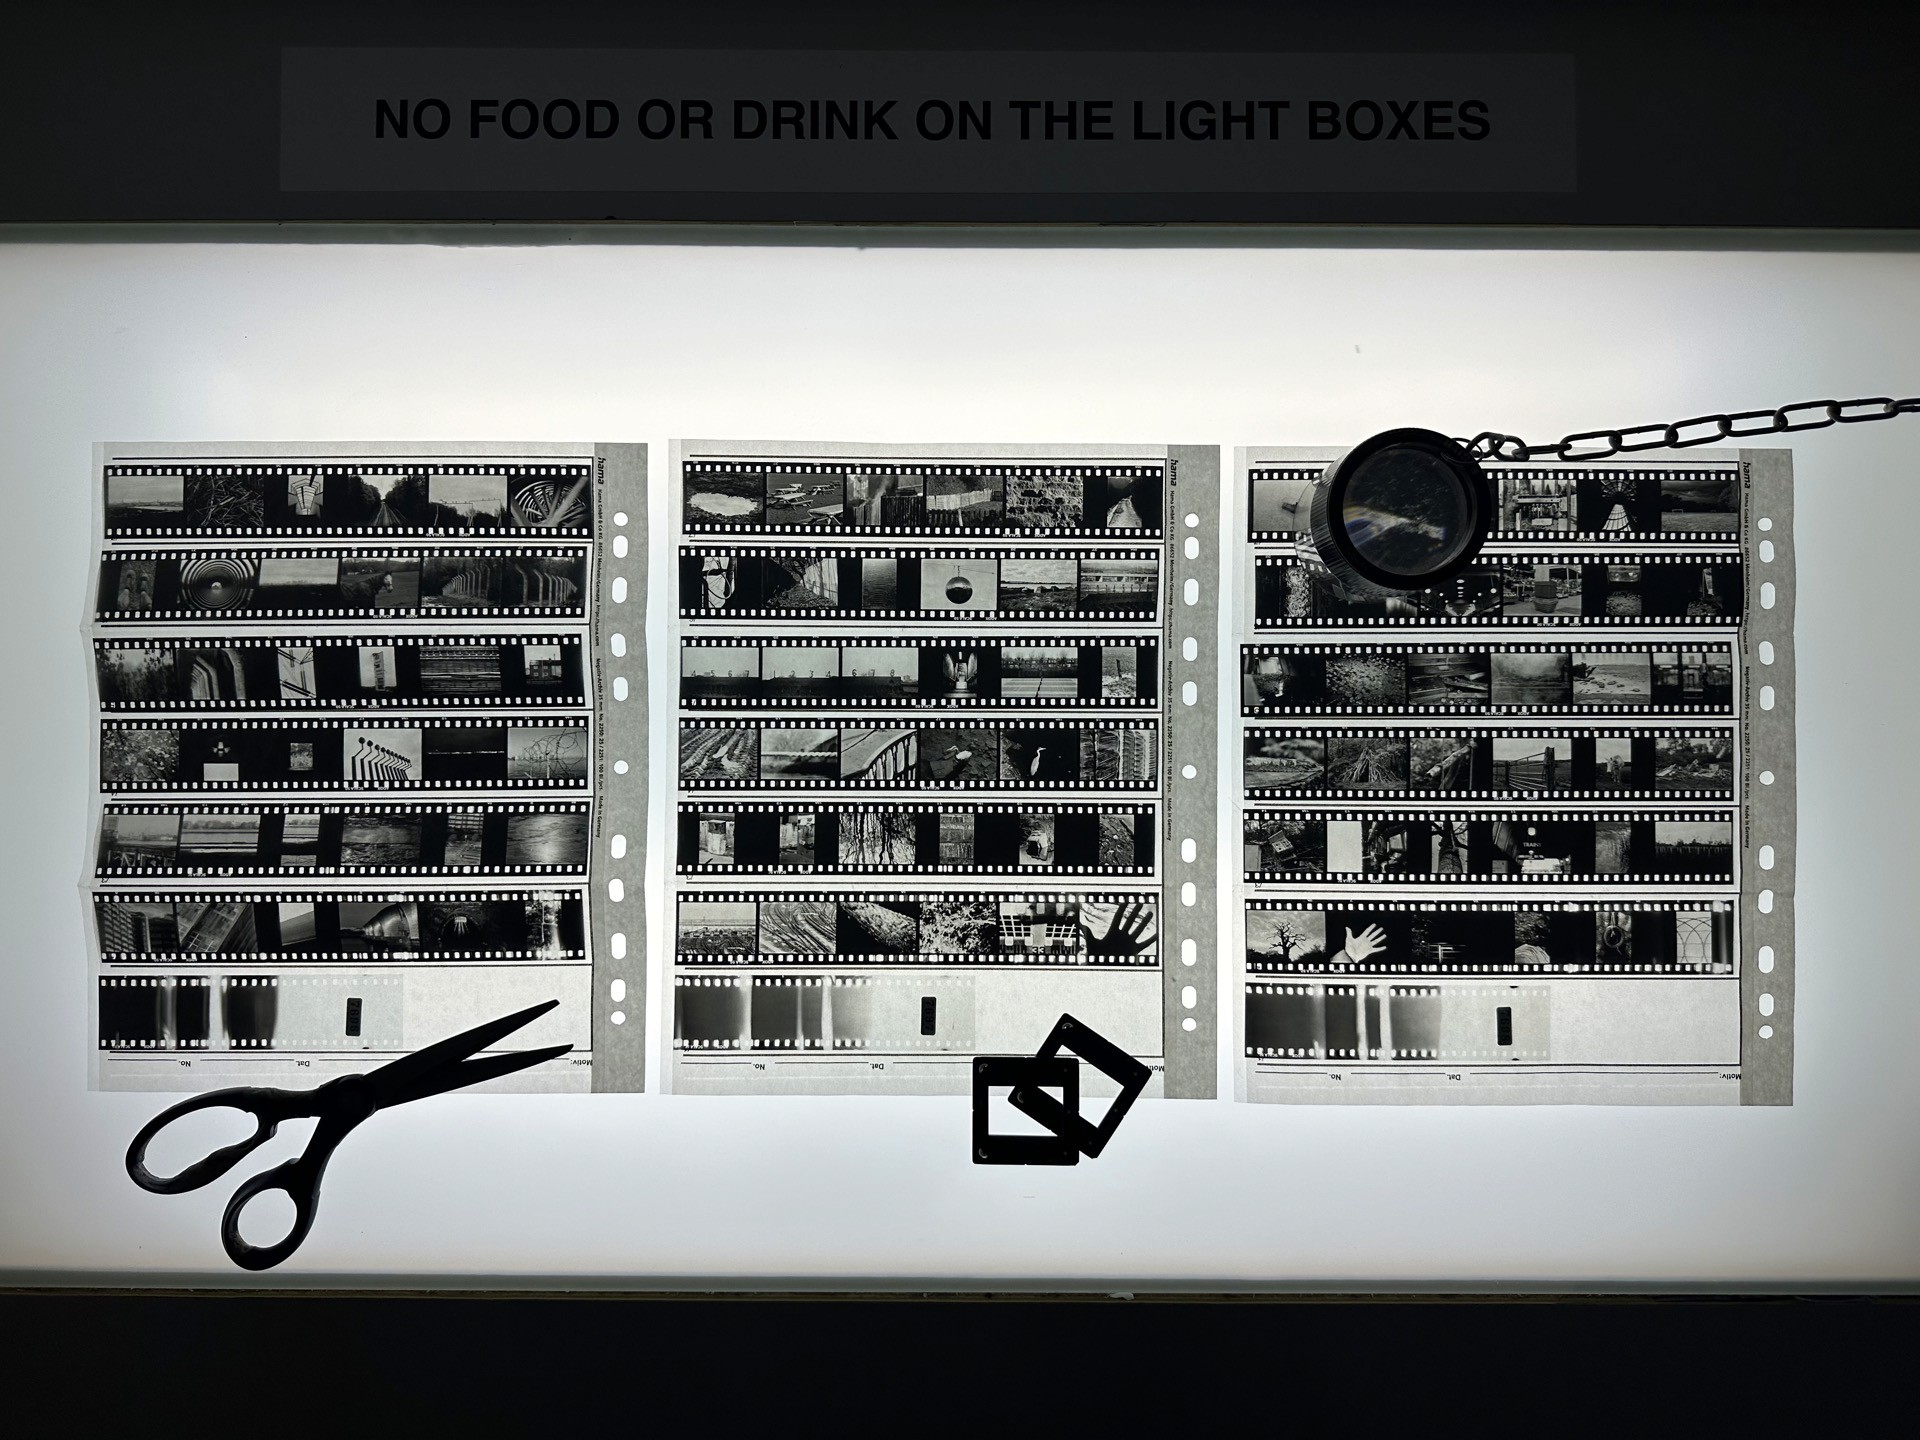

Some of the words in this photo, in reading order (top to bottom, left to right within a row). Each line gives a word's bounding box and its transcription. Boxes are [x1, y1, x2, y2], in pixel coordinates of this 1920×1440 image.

[375, 98, 451, 140] NO
[470, 98, 620, 140] FOOD
[637, 98, 714, 140] OR
[733, 99, 898, 141] DRINK
[915, 99, 992, 141] ON
[1008, 99, 1114, 141] THE
[1133, 99, 1291, 141] LIGHT
[1308, 99, 1491, 141] BOXES
[598, 457, 606, 485] hama
[1170, 459, 1178, 486] hama
[1743, 462, 1751, 489] hama
[924, 1000, 934, 1030] 7697
